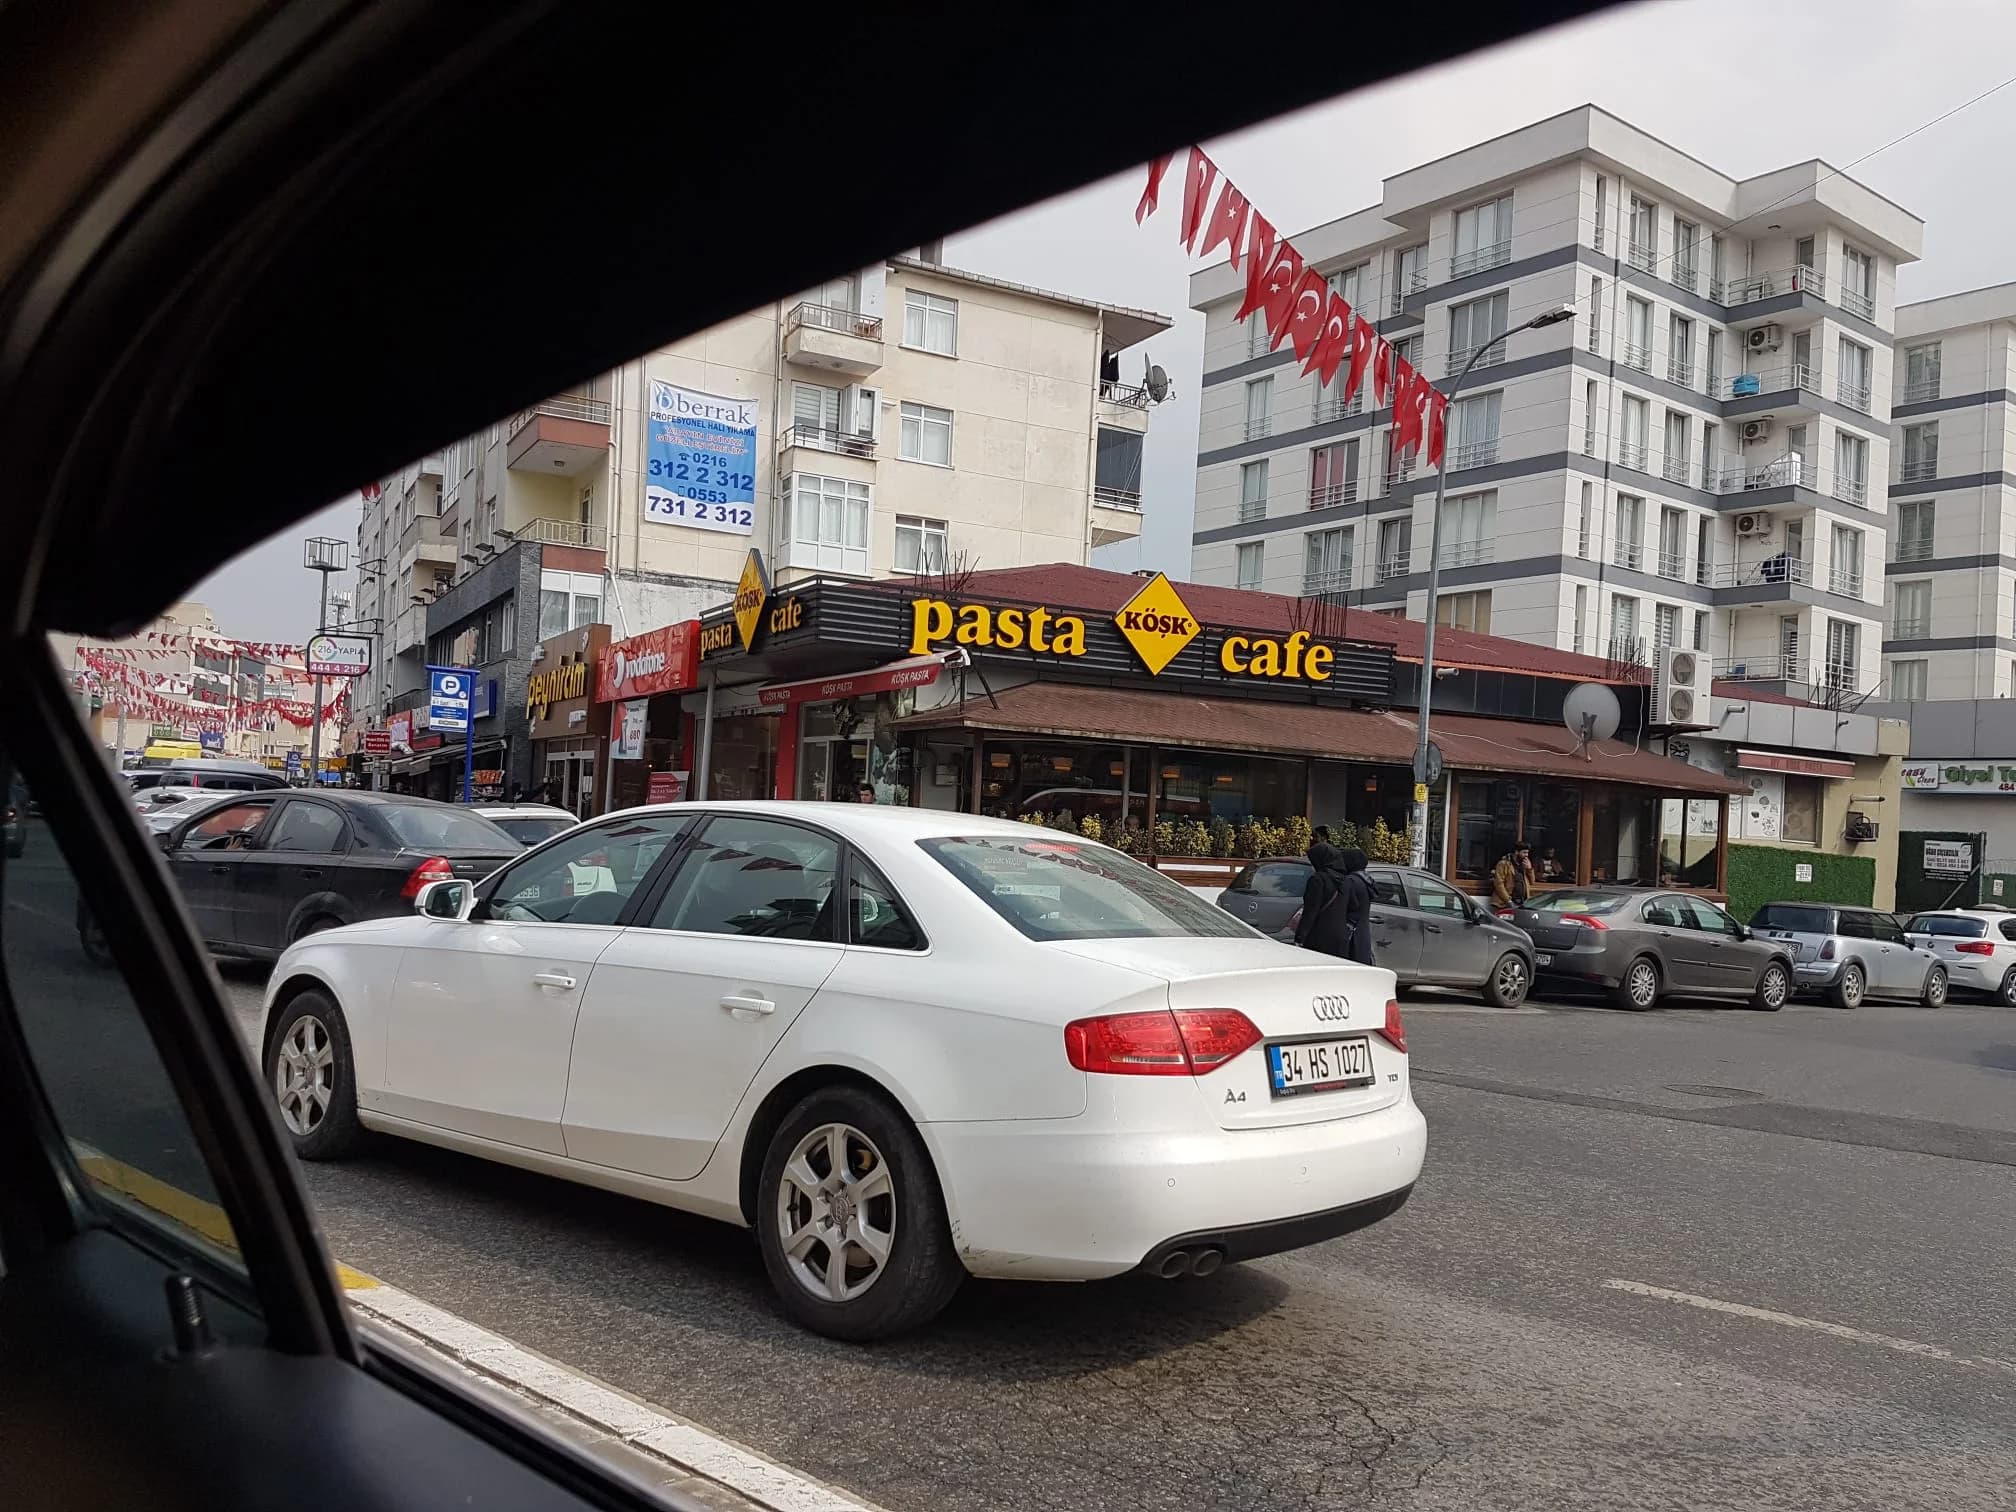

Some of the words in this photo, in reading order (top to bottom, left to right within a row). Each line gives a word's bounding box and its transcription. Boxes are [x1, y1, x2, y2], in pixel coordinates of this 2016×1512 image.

[651, 411, 705, 429] PROFESYONEL
[707, 421, 725, 434] HALI
[726, 425, 755, 437] YIKAMA
[677, 393, 752, 425] berrak
[649, 459, 689, 481] 312
[695, 467, 709, 484] 2
[716, 470, 754, 491] 312
[692, 452, 727, 468] 0216
[648, 495, 685, 516] 731
[694, 502, 708, 519] 2
[714, 506, 752, 526] 312
[687, 487, 727, 504] 0553
[736, 588, 762, 614] KÖŞK
[701, 623, 732, 661] pasta
[771, 596, 802, 633] cafe
[909, 598, 1088, 657] pasta
[1123, 607, 1189, 639] KÖŞK
[318, 645, 332, 654] 216
[338, 646, 357, 655] YAPI
[625, 648, 666, 679] vodafone
[1221, 630, 1335, 681] cafe
[311, 663, 330, 671] 444
[334, 665, 340, 673] 4
[910, 669, 930, 682] PASTA
[1282, 1051, 1302, 1082] 34
[1308, 1047, 1329, 1079] HS
[1335, 1043, 1365, 1076] 1027
[1223, 1088, 1247, 1105] A4
